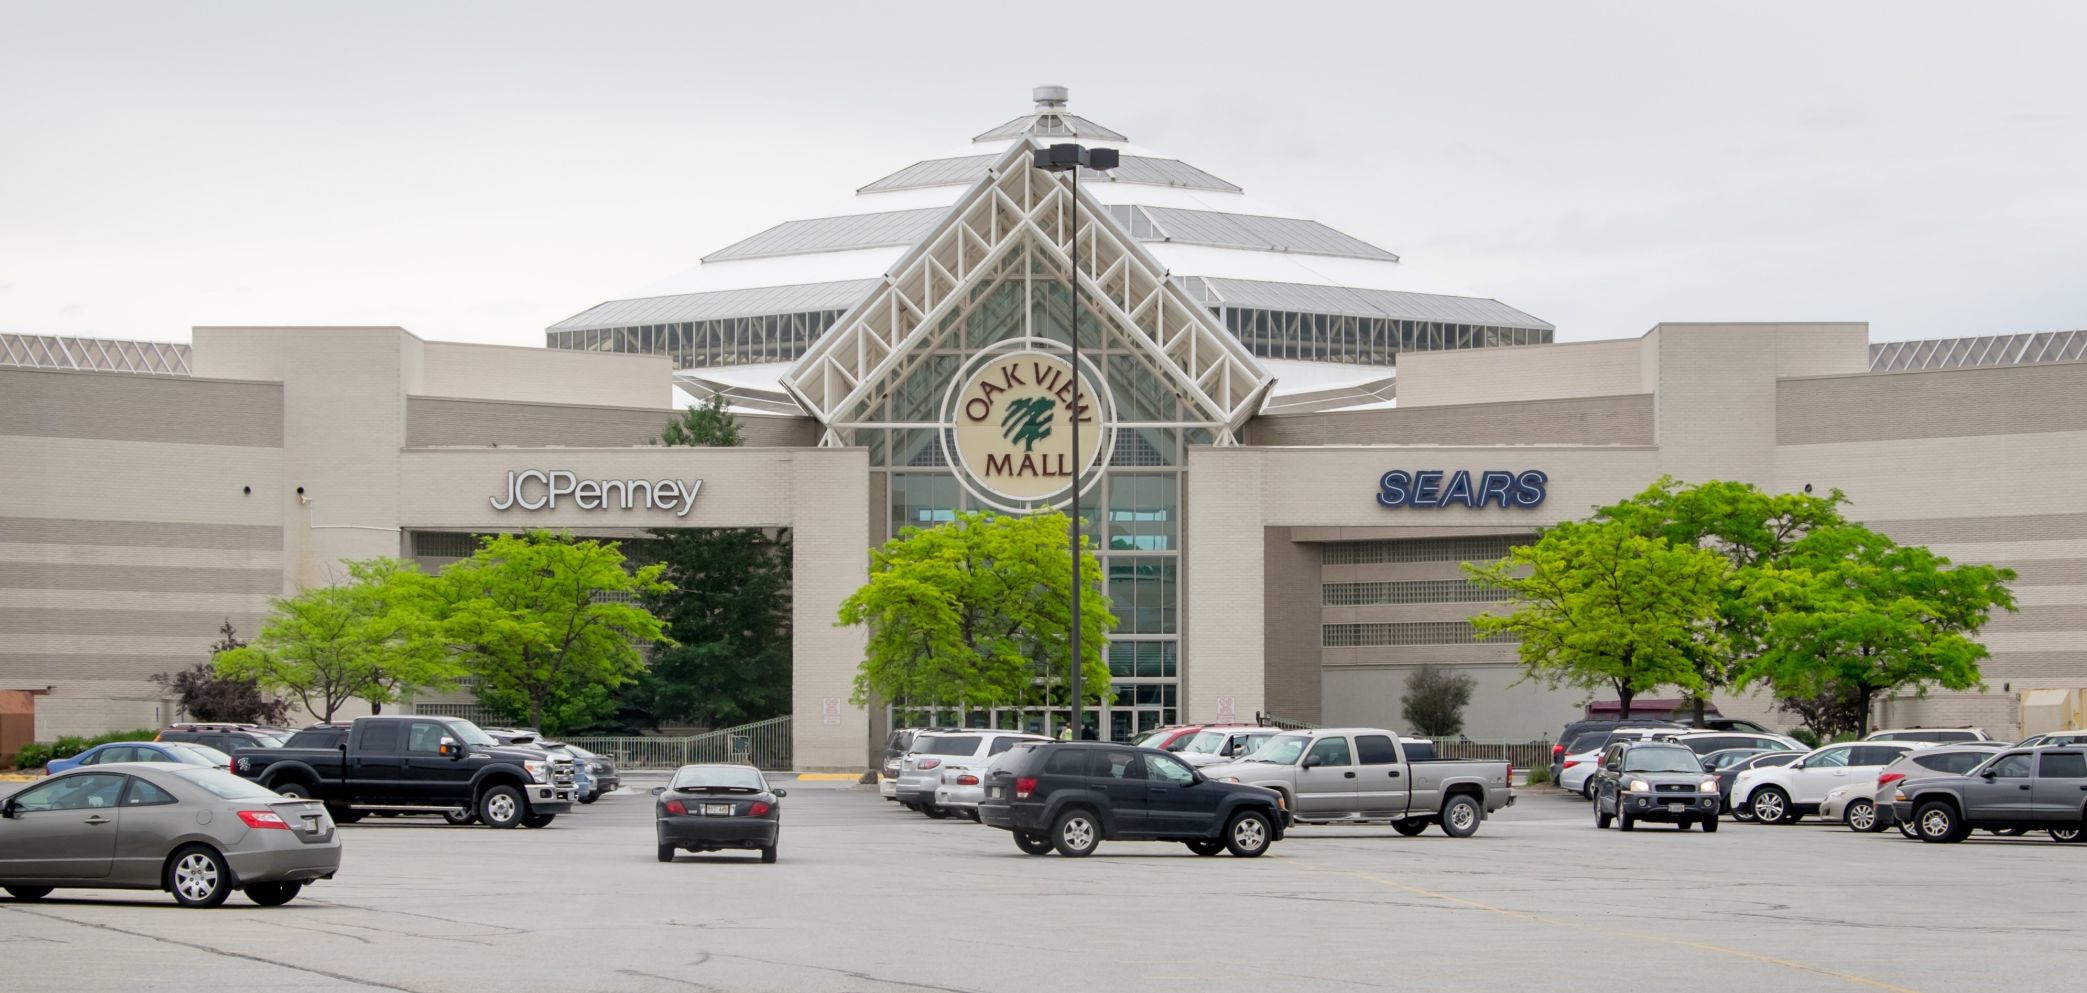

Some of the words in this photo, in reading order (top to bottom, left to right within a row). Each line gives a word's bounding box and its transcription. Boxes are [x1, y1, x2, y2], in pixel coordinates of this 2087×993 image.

[966, 363, 1026, 422] OAK
[1033, 362, 1092, 423] VIEW
[985, 453, 1073, 477] MALL
[489, 469, 703, 517] JCPenney
[1376, 470, 1548, 508] SEARS
